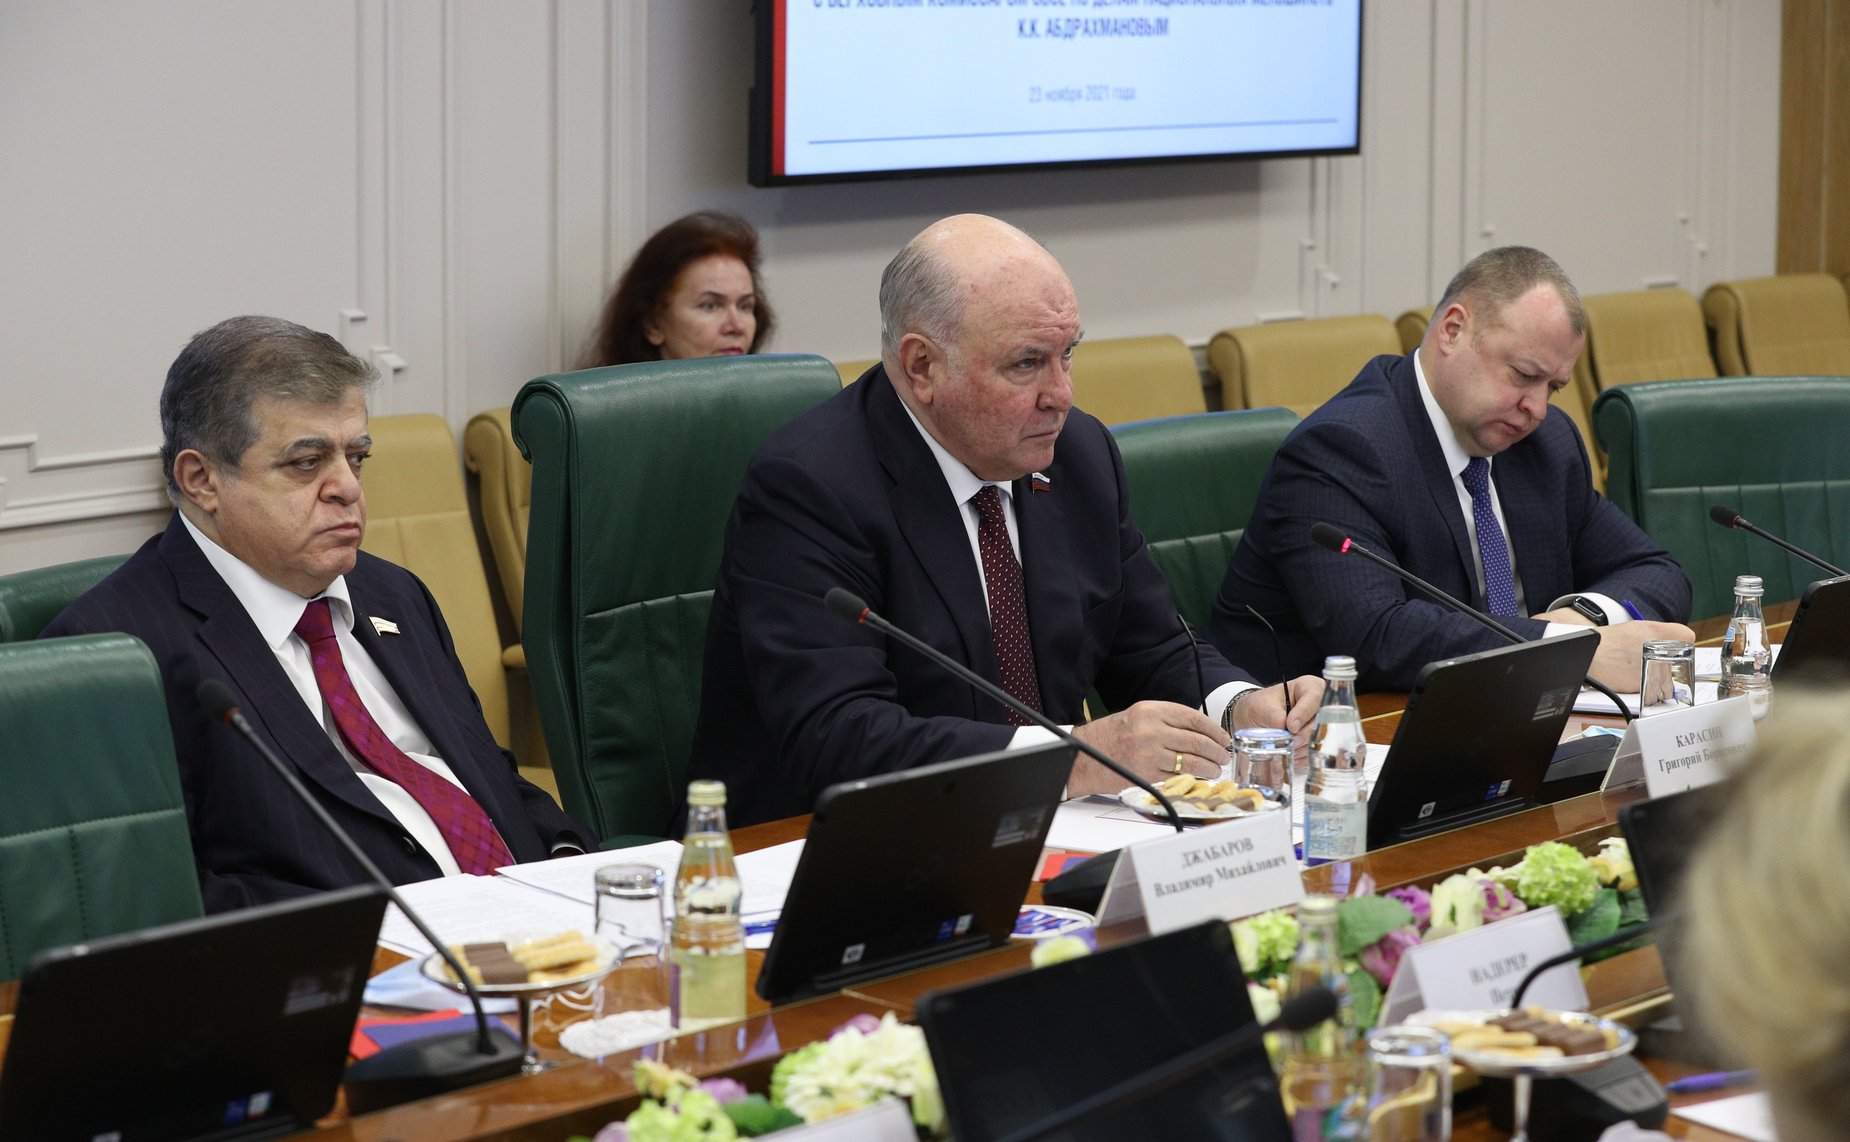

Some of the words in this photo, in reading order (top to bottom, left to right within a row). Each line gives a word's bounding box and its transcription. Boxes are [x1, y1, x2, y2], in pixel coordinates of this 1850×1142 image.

[1045, 17, 1169, 39] АБДРАХМАНОВЫМ
[1028, 86, 1041, 103] 23
[1085, 83, 1109, 102] 2021
[1675, 727, 1723, 748] КАРАСИН
[1658, 751, 1703, 774] Григорий
[1181, 838, 1254, 869] ДЖАБАРОВ
[1153, 874, 1214, 898] Владимир
[1215, 855, 1288, 880] Михайлович
